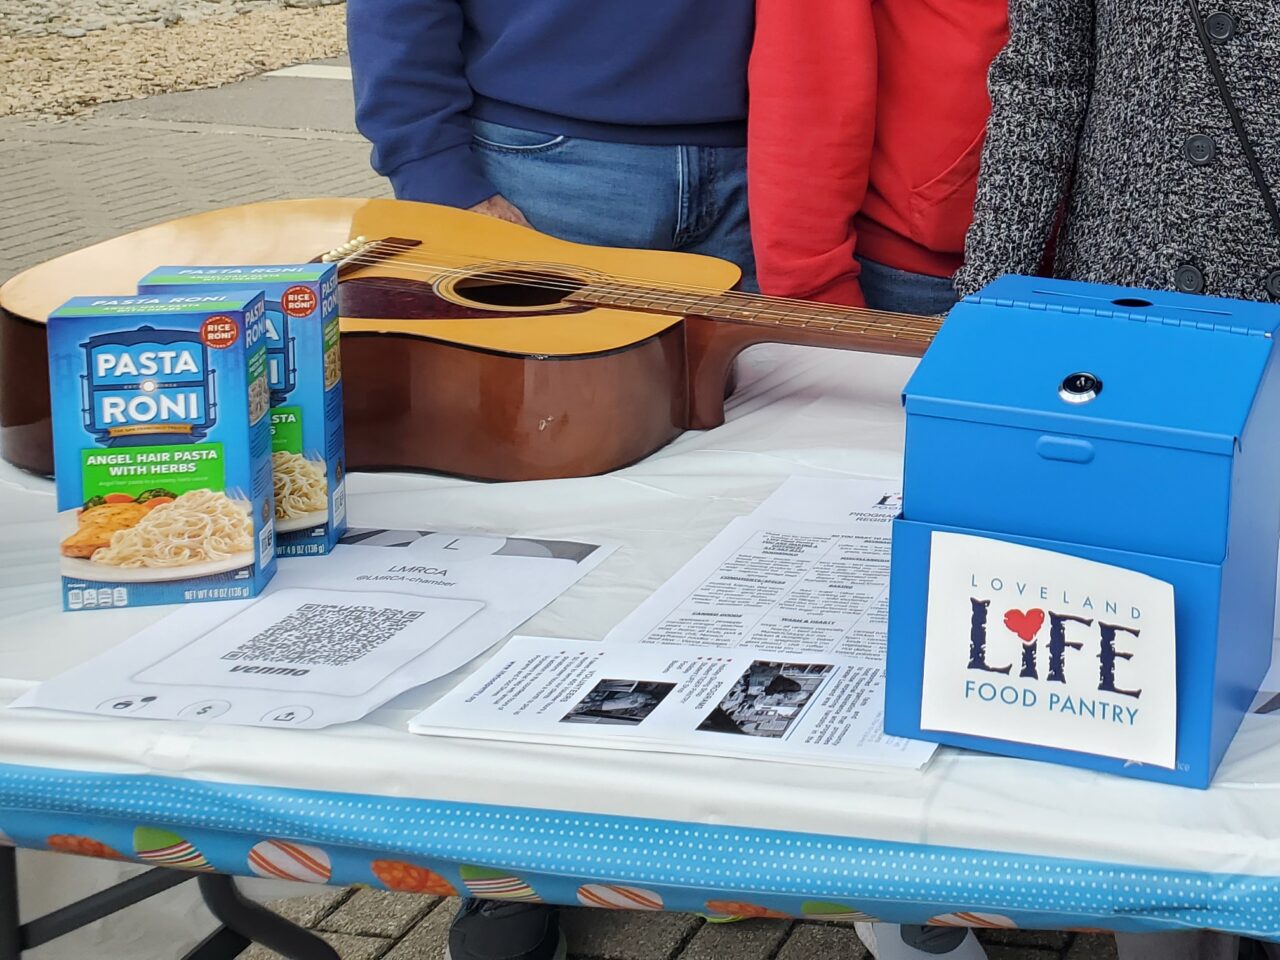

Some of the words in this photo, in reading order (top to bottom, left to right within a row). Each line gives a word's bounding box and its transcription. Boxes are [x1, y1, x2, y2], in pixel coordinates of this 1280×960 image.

[91, 297, 160, 307] PASTA
[168, 295, 226, 303] RONI
[245, 299, 264, 328] PASTA
[207, 330, 234, 340] RONI
[96, 350, 199, 377] PASTA
[102, 393, 199, 424] RONI
[271, 414, 296, 423] STA
[86, 454, 133, 465] ANGEL
[137, 452, 170, 462] HAIR
[174, 450, 218, 460] PASTA
[109, 466, 147, 476] WITH
[151, 463, 196, 474] HERBS
[388, 565, 449, 576] LMRCA
[356, 574, 457, 587] @LMRCA-chamber
[971, 573, 1141, 620] LOVELAND
[966, 596, 1143, 700] LIFE
[229, 665, 310, 676] venmo
[964, 680, 1038, 708] FOOD
[1049, 692, 1139, 726] PANTRY
